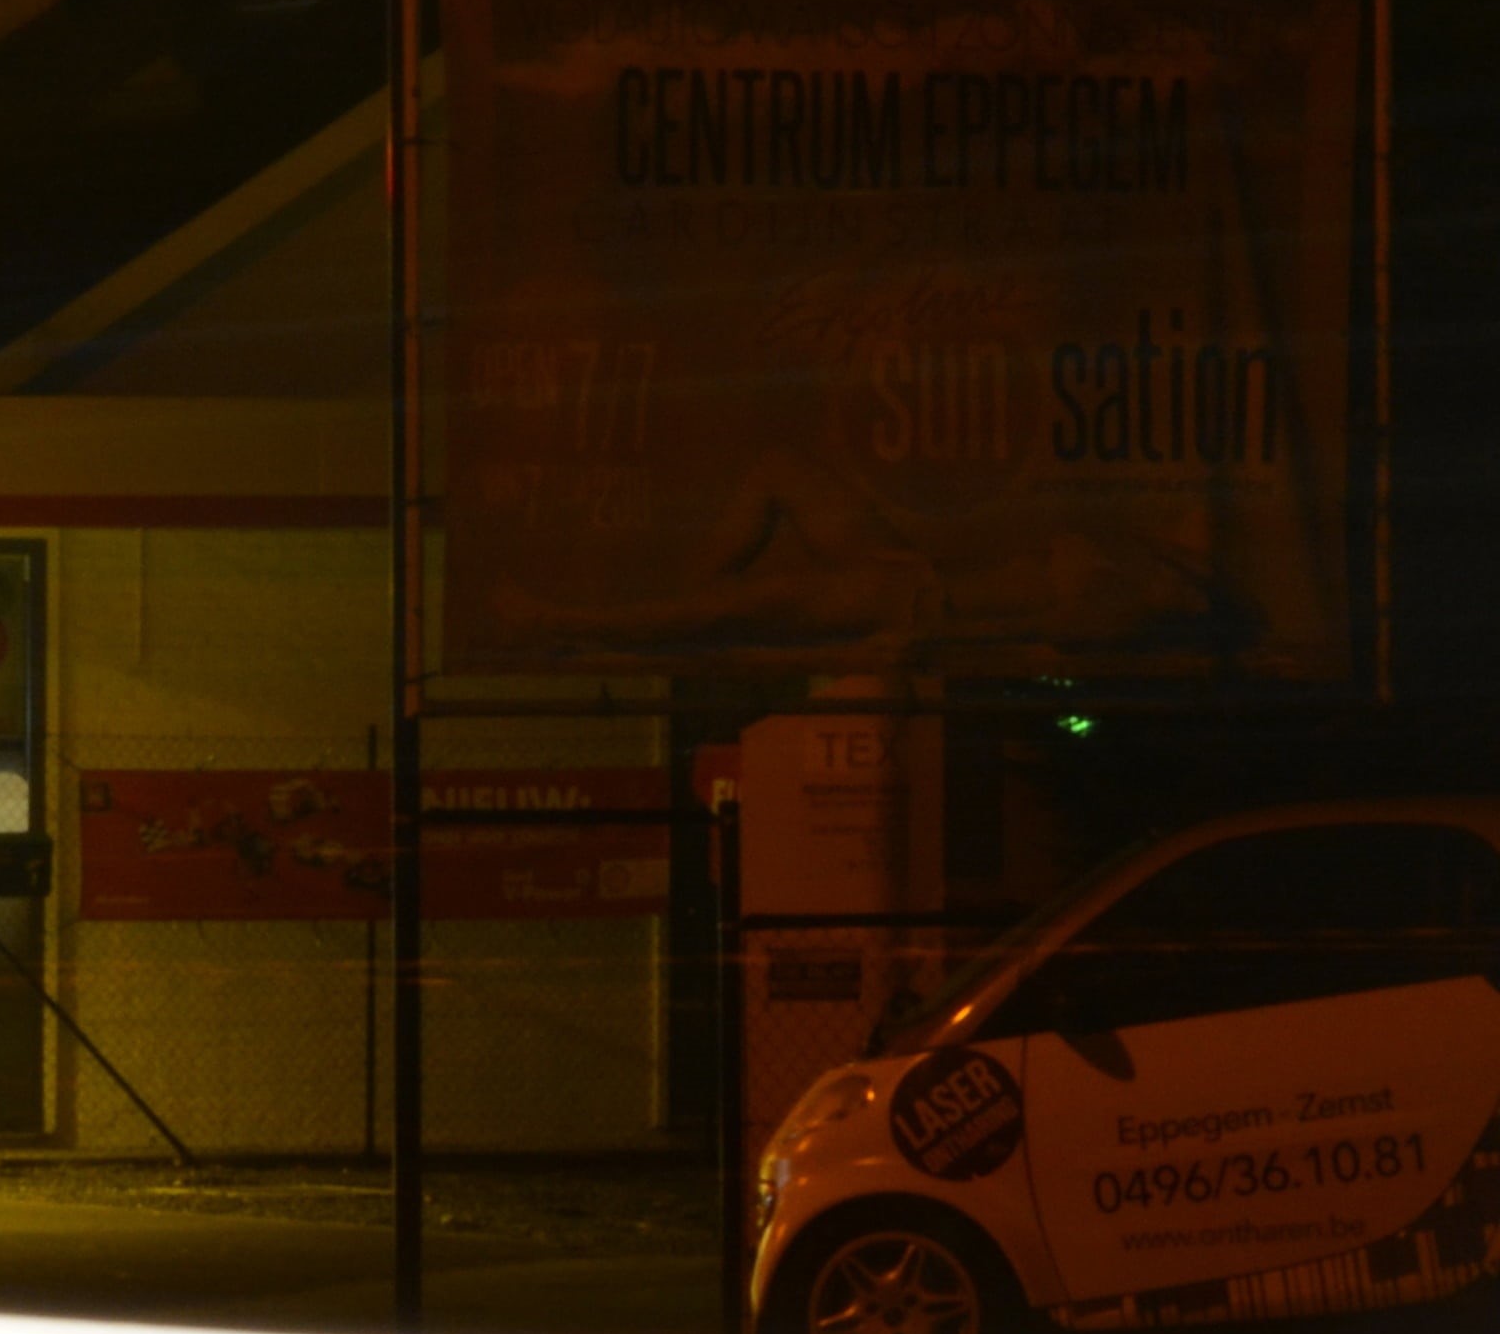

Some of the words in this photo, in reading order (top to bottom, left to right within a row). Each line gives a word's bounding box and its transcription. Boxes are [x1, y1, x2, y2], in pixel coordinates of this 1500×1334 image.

[617, 66, 902, 192] CENTRUM
[923, 70, 1192, 193] EPPEGEM
[1051, 305, 1279, 466] sation
[894, 1057, 1002, 1152] LASER
[1117, 1104, 1273, 1150] Eppegem
[1295, 1086, 1395, 1124] Zemst
[1092, 1132, 1425, 1214] 0496/36.10.81
[1120, 1213, 1366, 1252] www.ontharen.be
